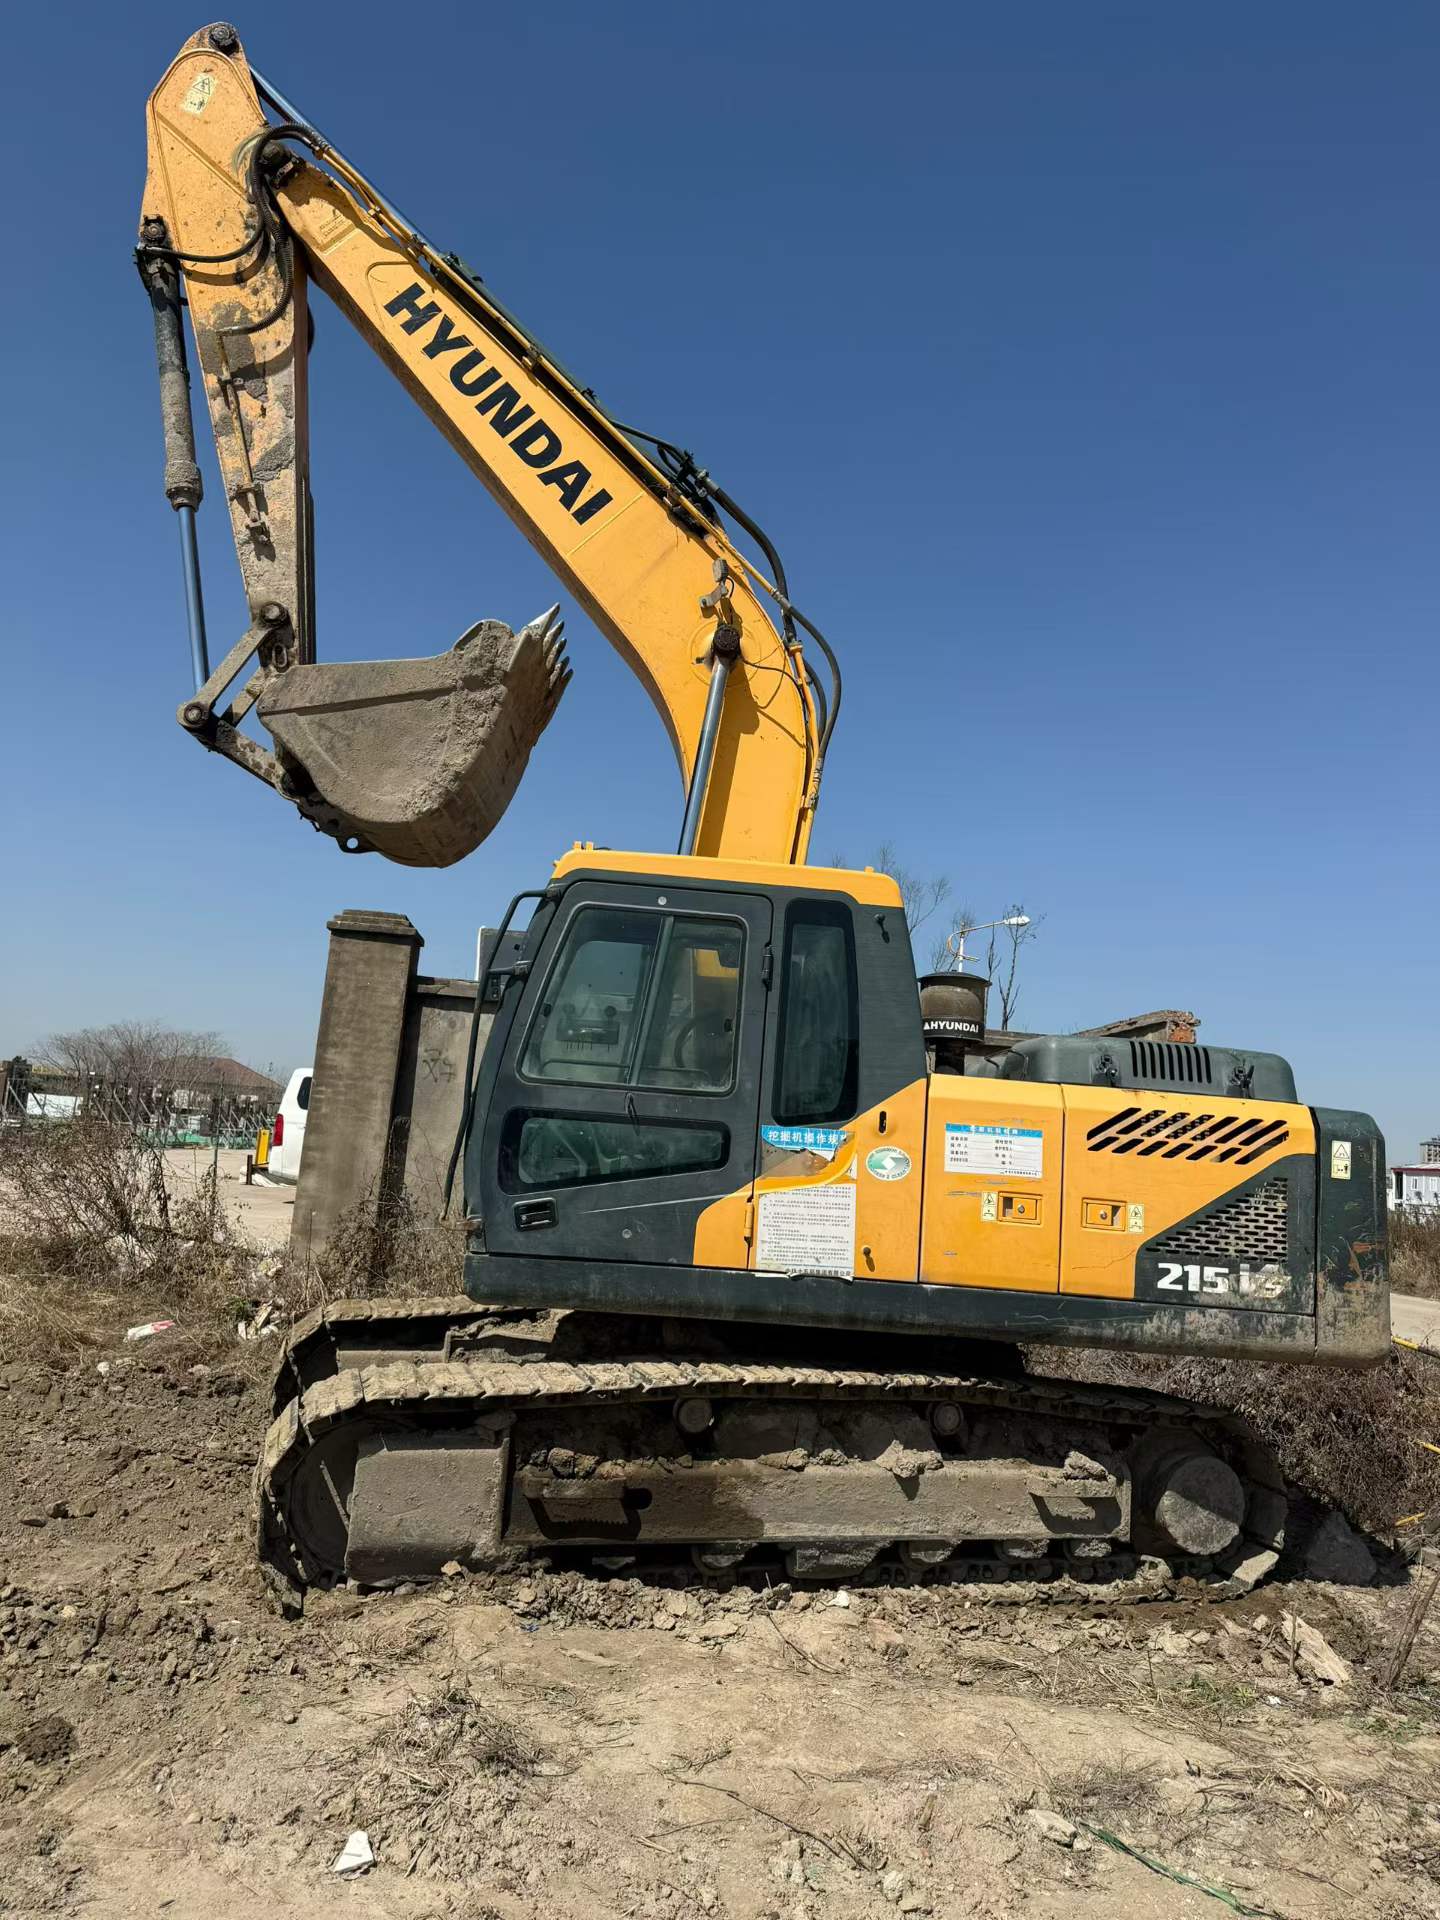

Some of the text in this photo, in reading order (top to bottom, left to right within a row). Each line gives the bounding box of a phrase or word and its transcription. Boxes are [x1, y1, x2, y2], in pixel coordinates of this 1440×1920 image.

[383, 281, 614, 526] HYUNDAI
[930, 1020, 979, 1033] HYUNDAI
[1157, 1262, 1229, 1294] 215
